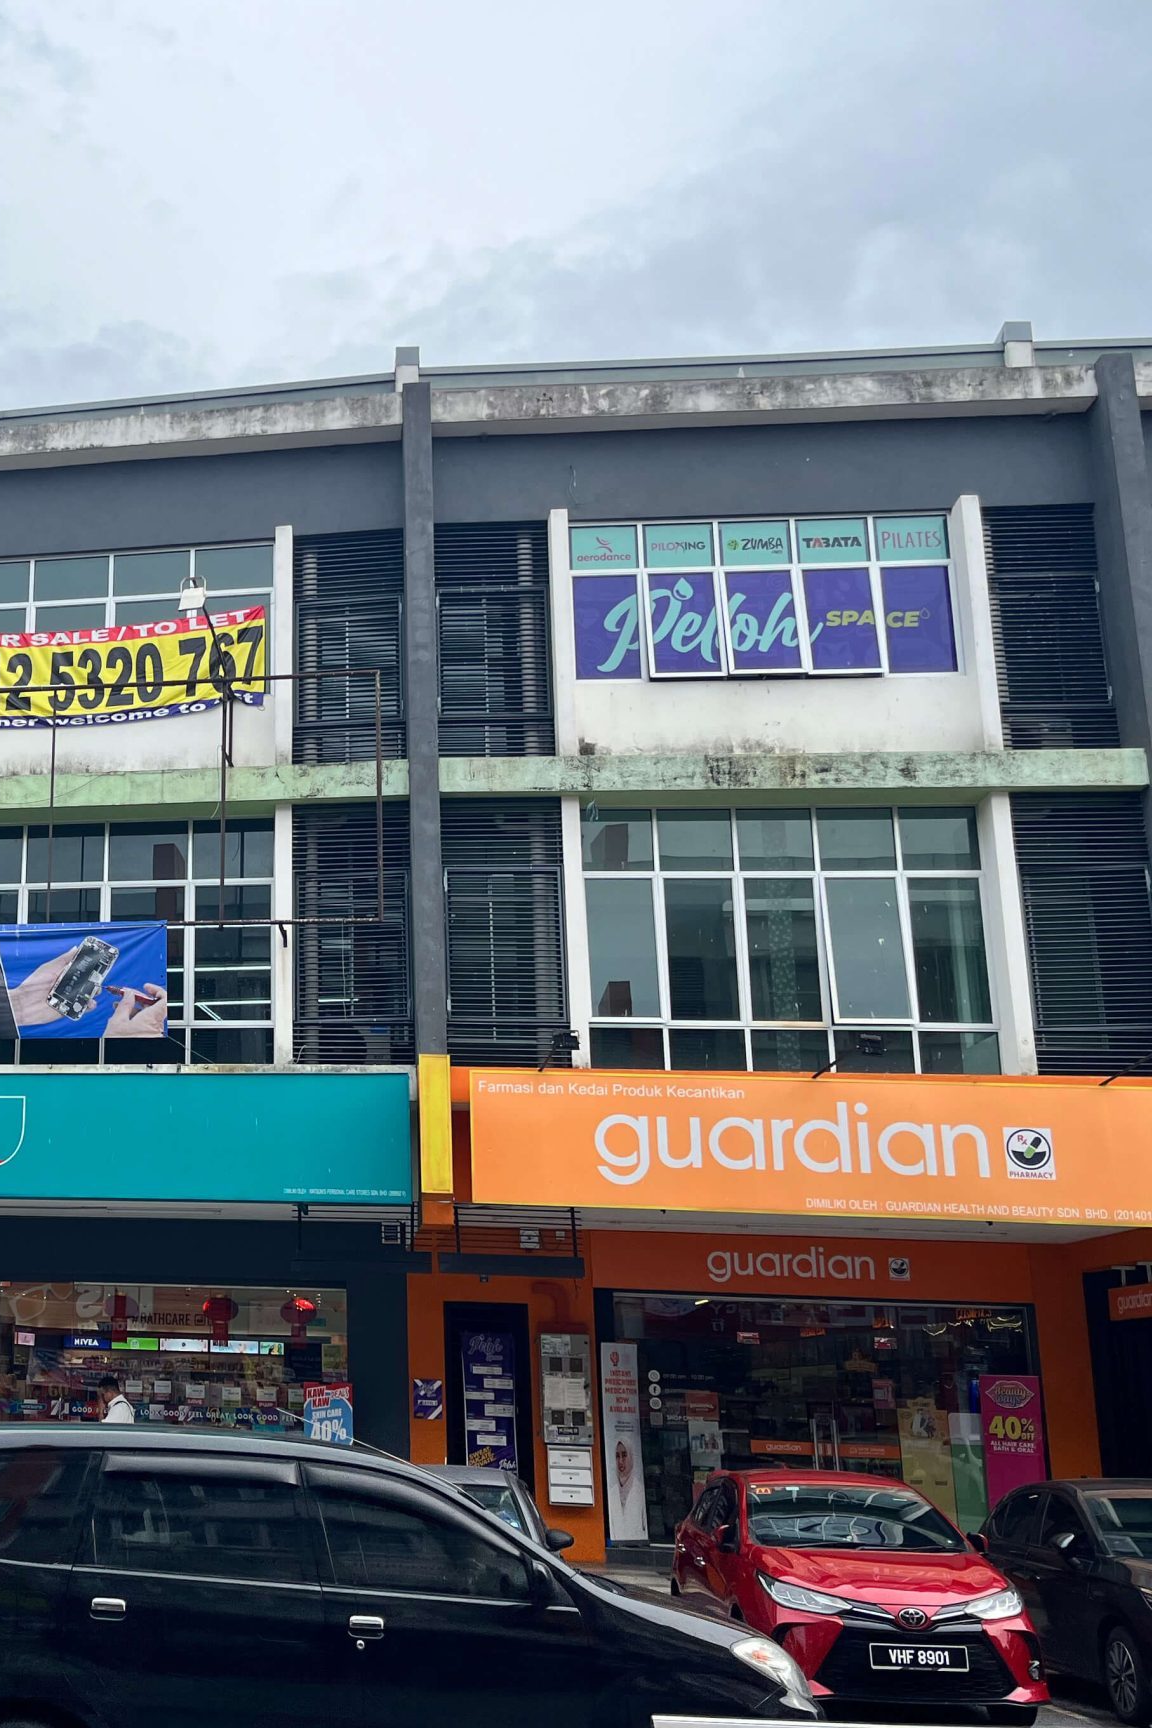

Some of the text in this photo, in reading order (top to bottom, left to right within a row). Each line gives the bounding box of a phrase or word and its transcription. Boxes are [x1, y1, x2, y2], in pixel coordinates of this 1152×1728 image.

[651, 541, 706, 553] PILOXING
[742, 537, 783, 550] ZUMBA
[802, 536, 862, 548] TABATA
[881, 531, 942, 549] PILATES
[577, 553, 631, 562] aerodance
[825, 610, 920, 628] SPACE
[30, 629, 109, 646] SALE
[133, 622, 177, 637] TO
[189, 609, 250, 630] LET
[48, 643, 164, 711] 5320
[179, 625, 263, 697] 767
[47, 707, 170, 726] welcome
[178, 701, 206, 713] to
[478, 1081, 745, 1099] Farmasi dan Kedai Produk Kecantikan
[594, 1101, 991, 1185] guardian
[1009, 1171, 1054, 1179] PHARMACY
[806, 1198, 847, 1210] DIMILIKI
[849, 1199, 878, 1211] OLEH
[885, 1201, 941, 1213] GUARDIAN
[944, 1203, 985, 1215] HEALTH
[986, 1204, 1010, 1216] AND
[1012, 1205, 1054, 1217] BEAUTY
[707, 1246, 876, 1283] guardian
[74, 1338, 98, 1346] NIVEA
[307, 1386, 326, 1398] KAW
[313, 1397, 330, 1408] KAW
[233, 1412, 253, 1421] LOOK
[327, 1408, 342, 1417] CARE
[888, 1649, 950, 1665] VHF 8901
